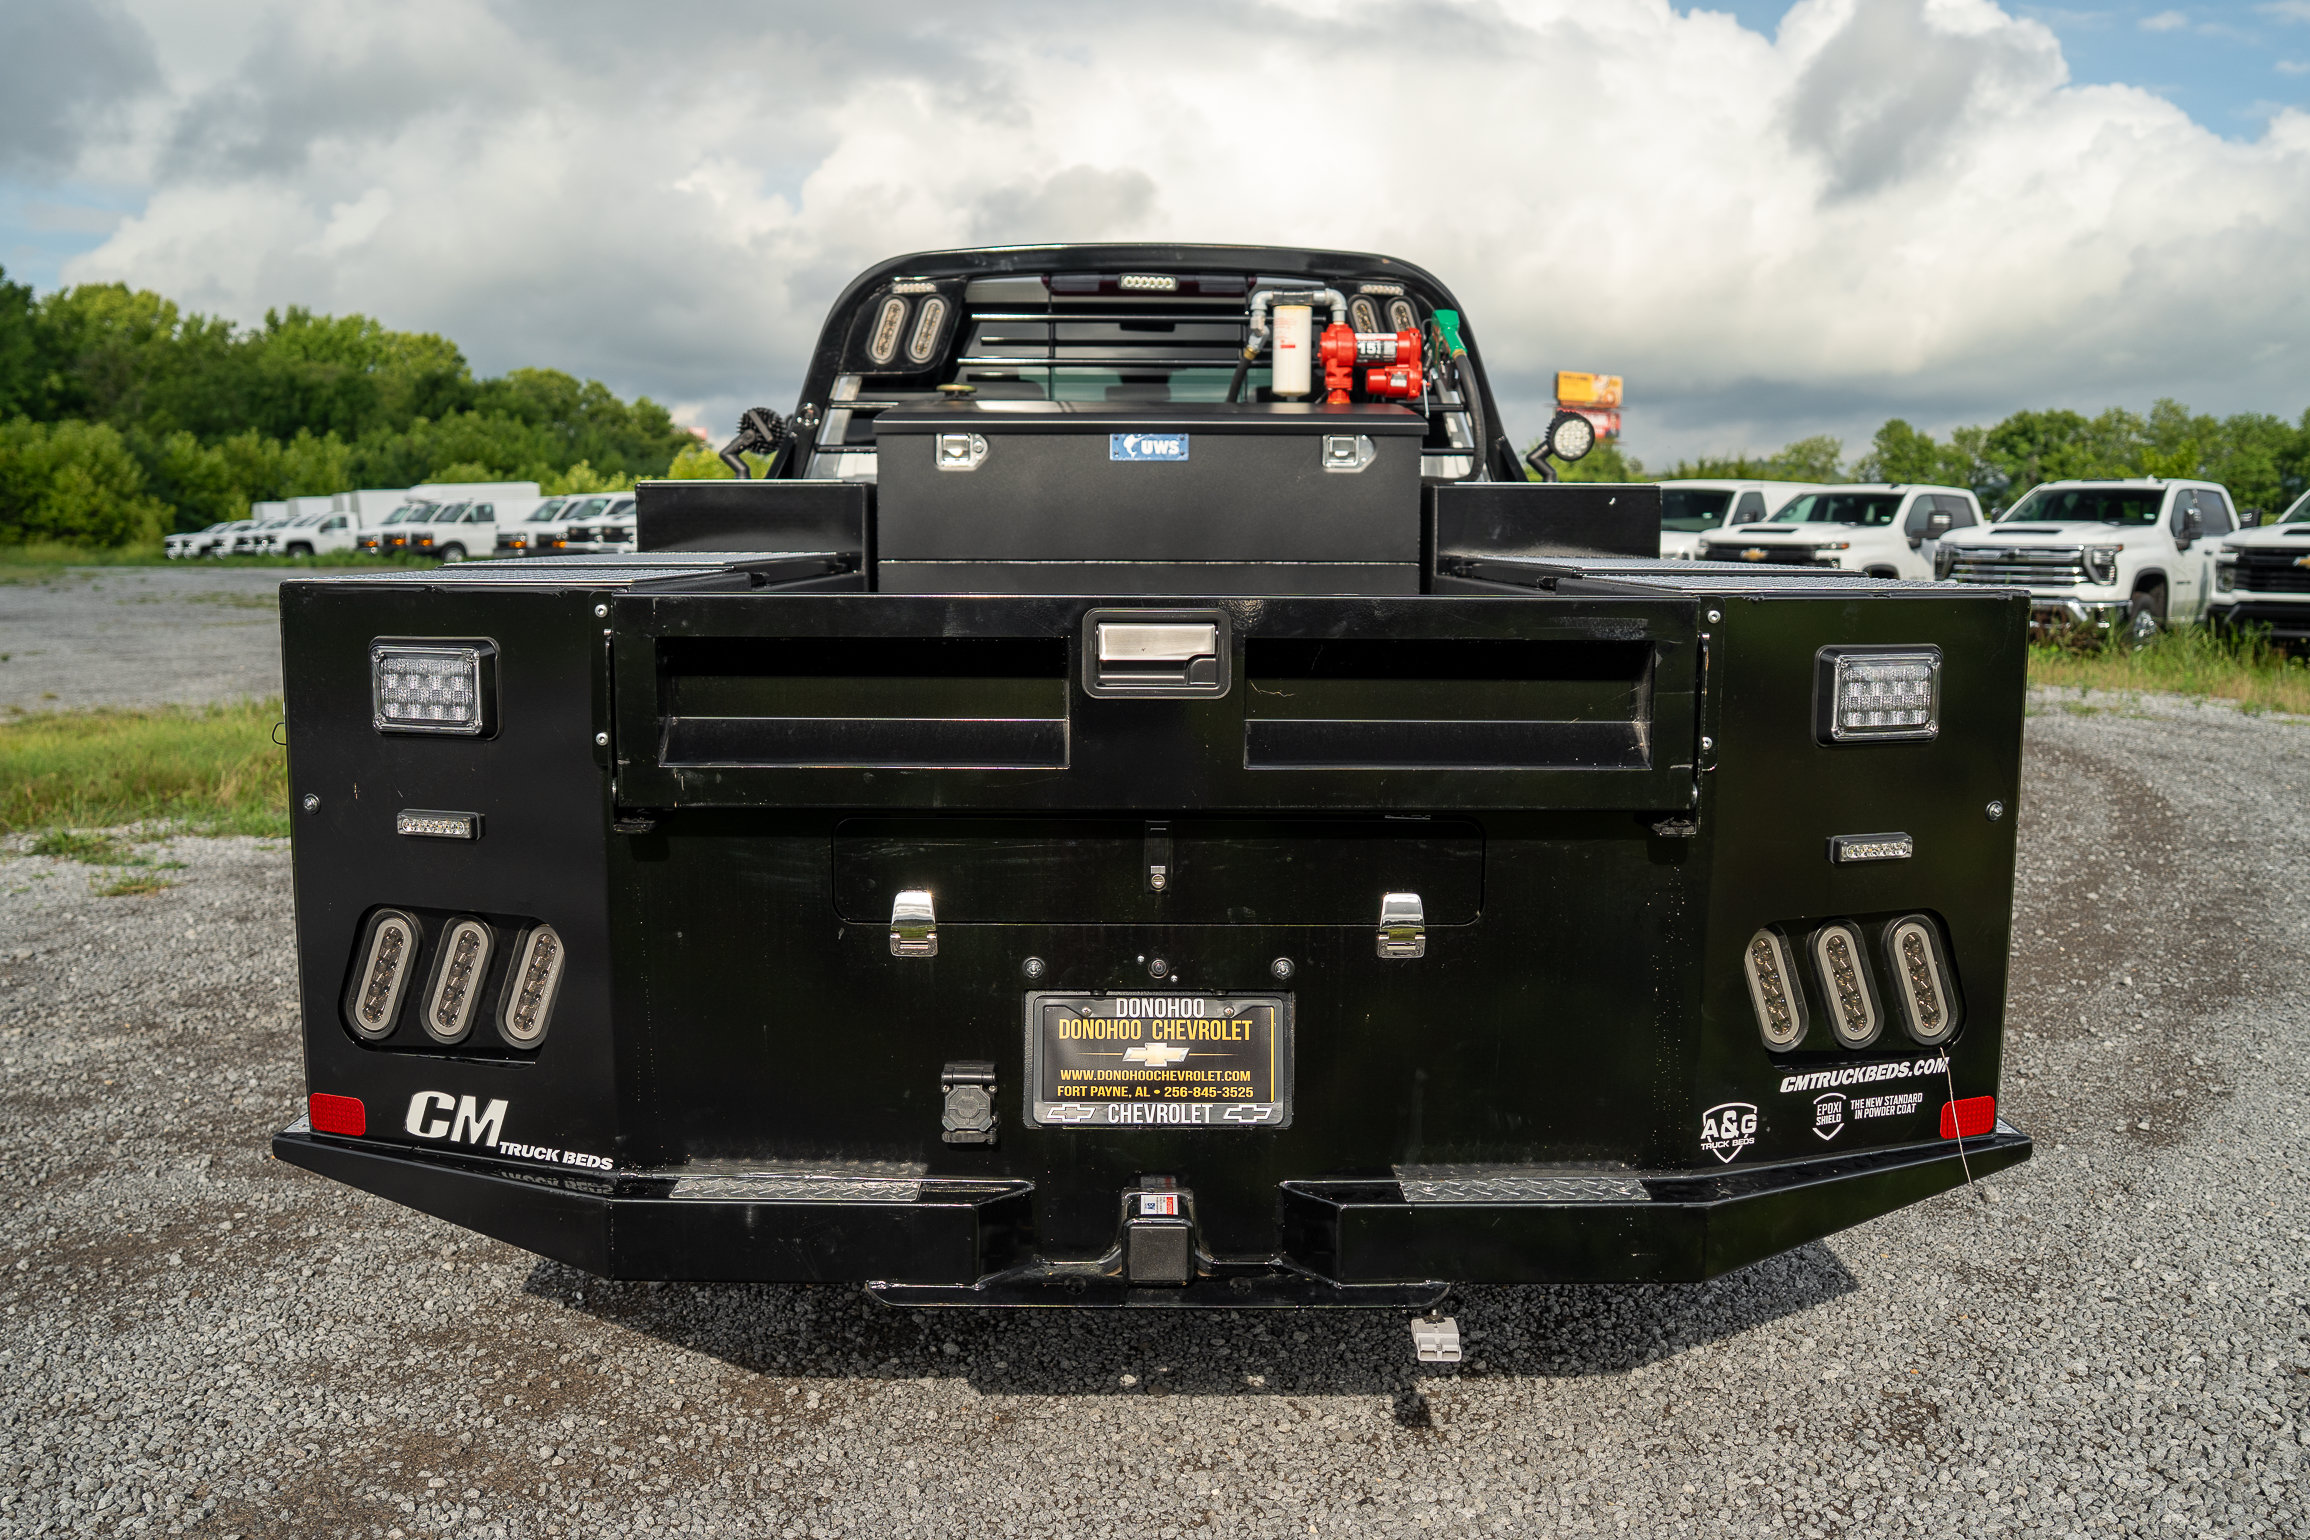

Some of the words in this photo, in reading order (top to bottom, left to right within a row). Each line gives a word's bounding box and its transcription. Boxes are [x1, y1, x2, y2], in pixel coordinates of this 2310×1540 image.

[1141, 439, 1180, 455] UWS
[1116, 998, 1206, 1018] DONOHOO
[1059, 1019, 1142, 1041] DONOHOO
[1152, 1020, 1253, 1041] CHEVROLET
[1060, 1069, 1251, 1082] WWW.DONOHOOCHEVROLET.COM
[1779, 1056, 1950, 1093] CMTRUCKBEDS.COM
[1057, 1085, 1088, 1097] FORT
[1090, 1086, 1132, 1099] PAYNE,
[1135, 1086, 1151, 1097] AL
[1164, 1086, 1254, 1098] 256-845-3525
[1816, 1101, 1842, 1116] EPOXI
[1850, 1099, 1865, 1110] THE
[1865, 1096, 1884, 1108] NEW
[1884, 1092, 1923, 1106] STANDARD
[1107, 1103, 1213, 1124] CHEVROLET
[1815, 1113, 1842, 1126] SHIELD
[1854, 1109, 1863, 1120] IN
[1864, 1105, 1896, 1118] POWDER
[1896, 1103, 1917, 1115] COAT
[404, 1090, 509, 1148] CM
[500, 1141, 560, 1163] TRUCK
[562, 1150, 614, 1171] BEDS
[1700, 1110, 1758, 1139] A&G
[1700, 1140, 1730, 1150] TRUCK
[1732, 1137, 1755, 1146] BEDS
